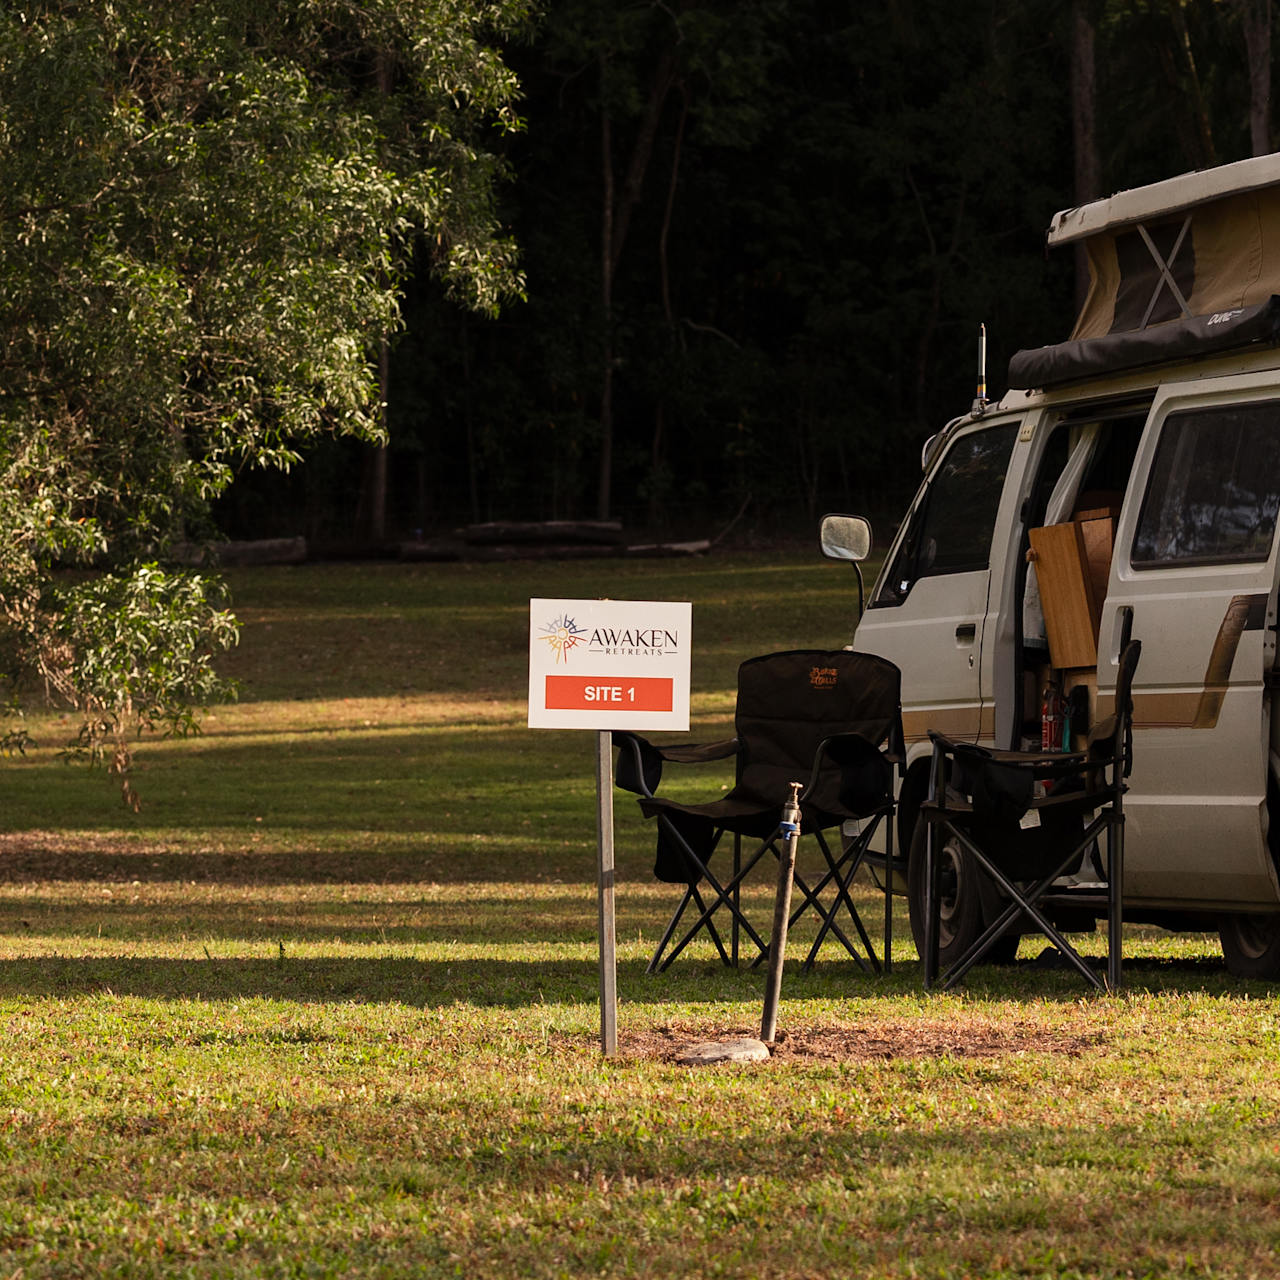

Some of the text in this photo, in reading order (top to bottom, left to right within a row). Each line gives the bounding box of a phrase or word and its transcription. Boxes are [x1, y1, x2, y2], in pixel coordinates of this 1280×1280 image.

[589, 628, 679, 648] AWAKEN
[605, 648, 662, 656] RETREATS
[584, 686, 635, 702] SITE 1
